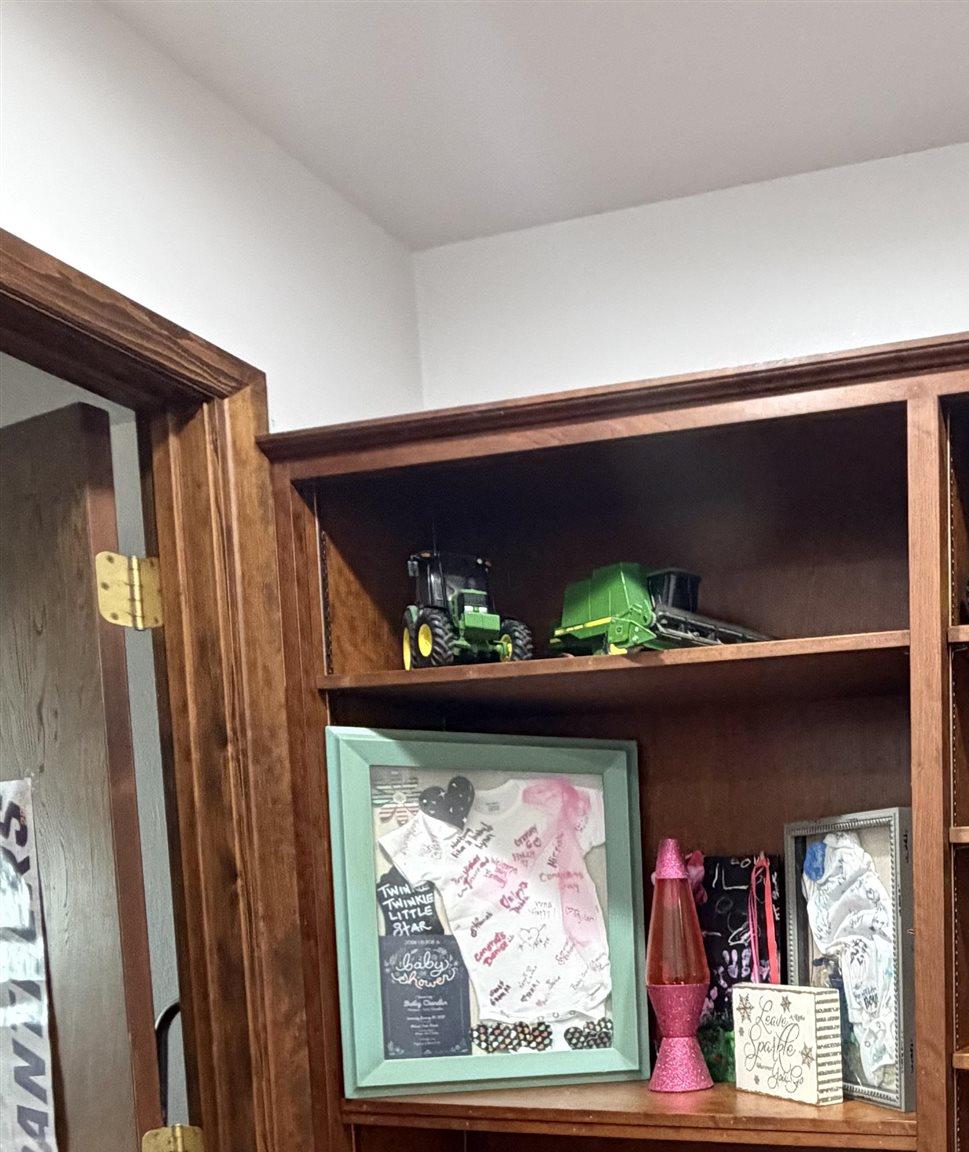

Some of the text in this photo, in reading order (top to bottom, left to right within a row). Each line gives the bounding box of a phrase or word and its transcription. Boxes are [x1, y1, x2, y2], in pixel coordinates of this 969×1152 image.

[382, 893, 434, 911] TWINKLE
[388, 905, 434, 921] LITTLE
[395, 950, 450, 978] baby
[391, 968, 458, 990] shower
[755, 995, 789, 1035] Leave
